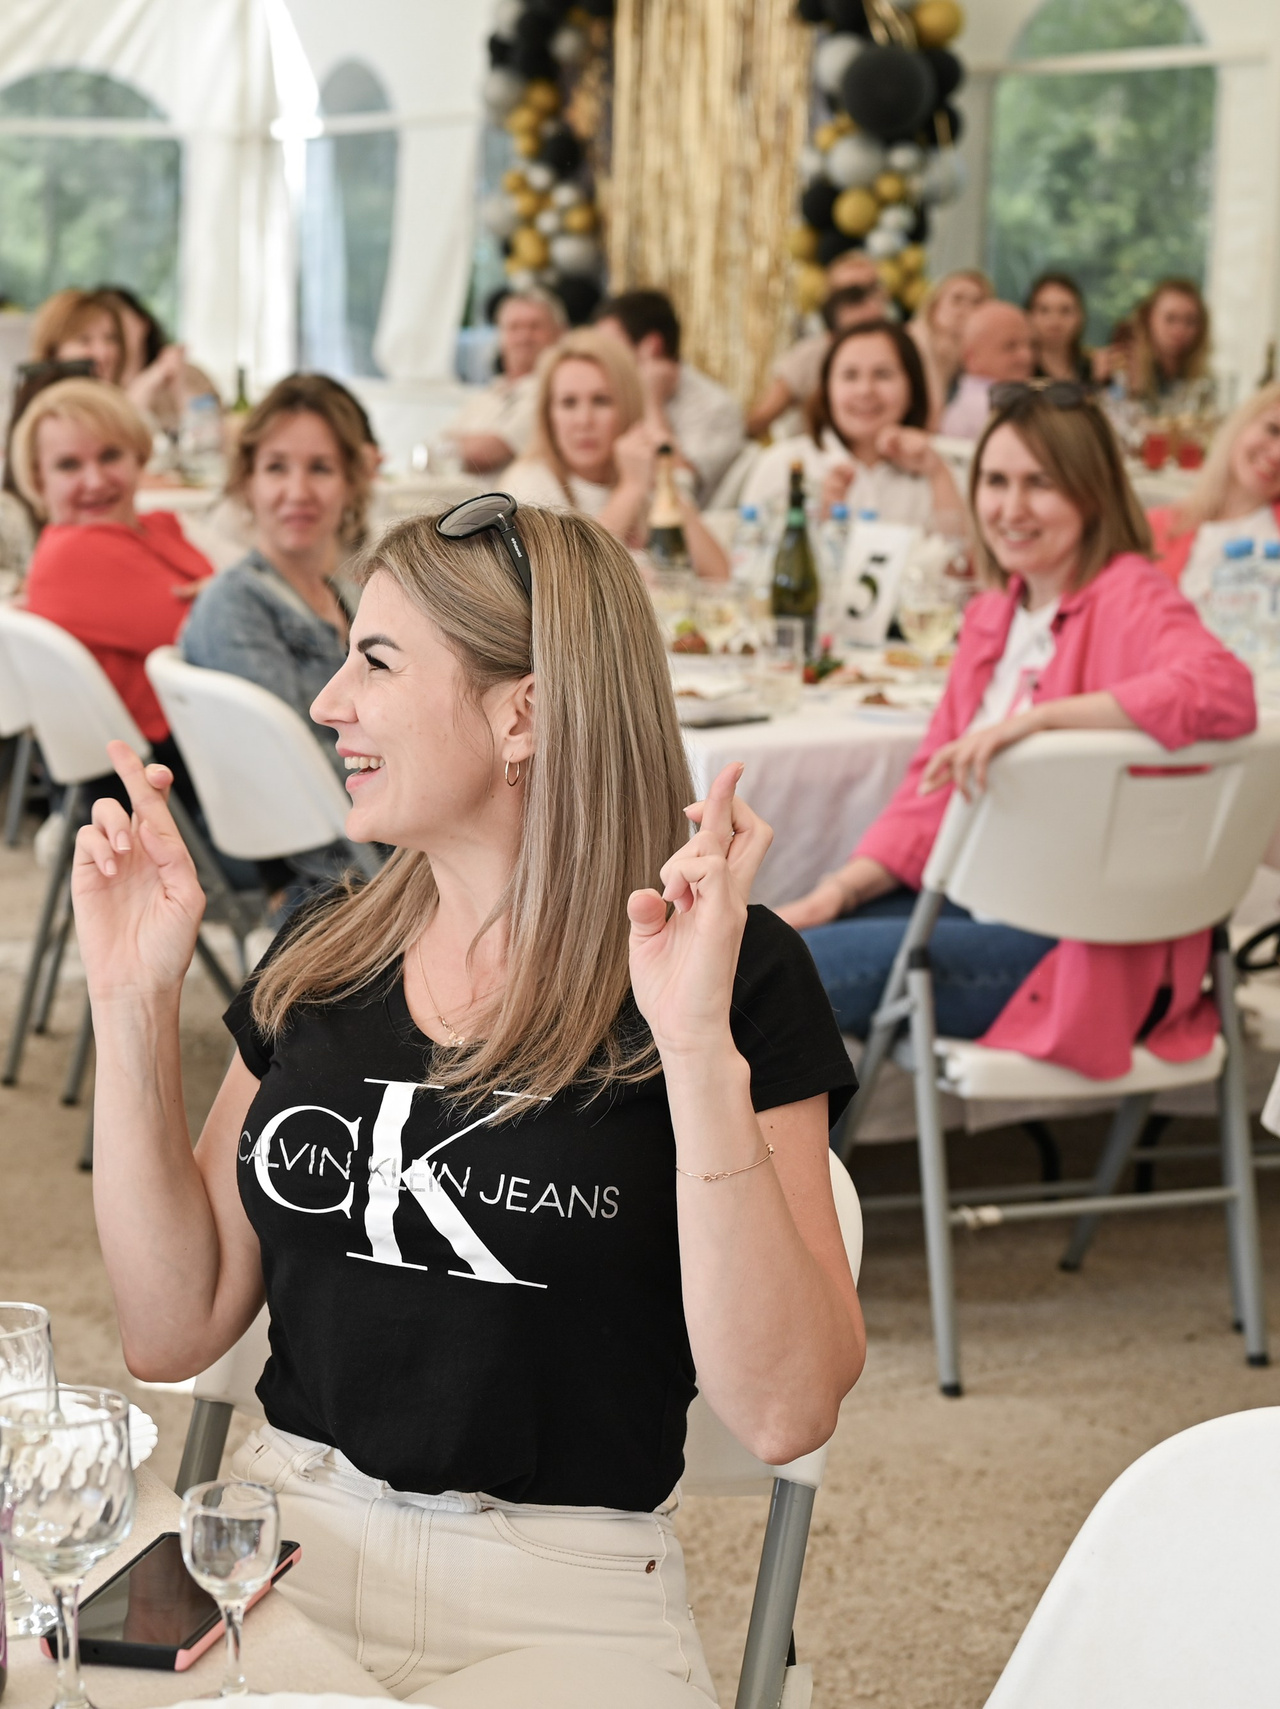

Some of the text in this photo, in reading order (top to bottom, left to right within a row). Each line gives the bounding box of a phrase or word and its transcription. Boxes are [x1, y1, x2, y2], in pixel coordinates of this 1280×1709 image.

[845, 552, 888, 619] 5
[238, 1129, 620, 1220] CALVIN KLEIN JEANS
